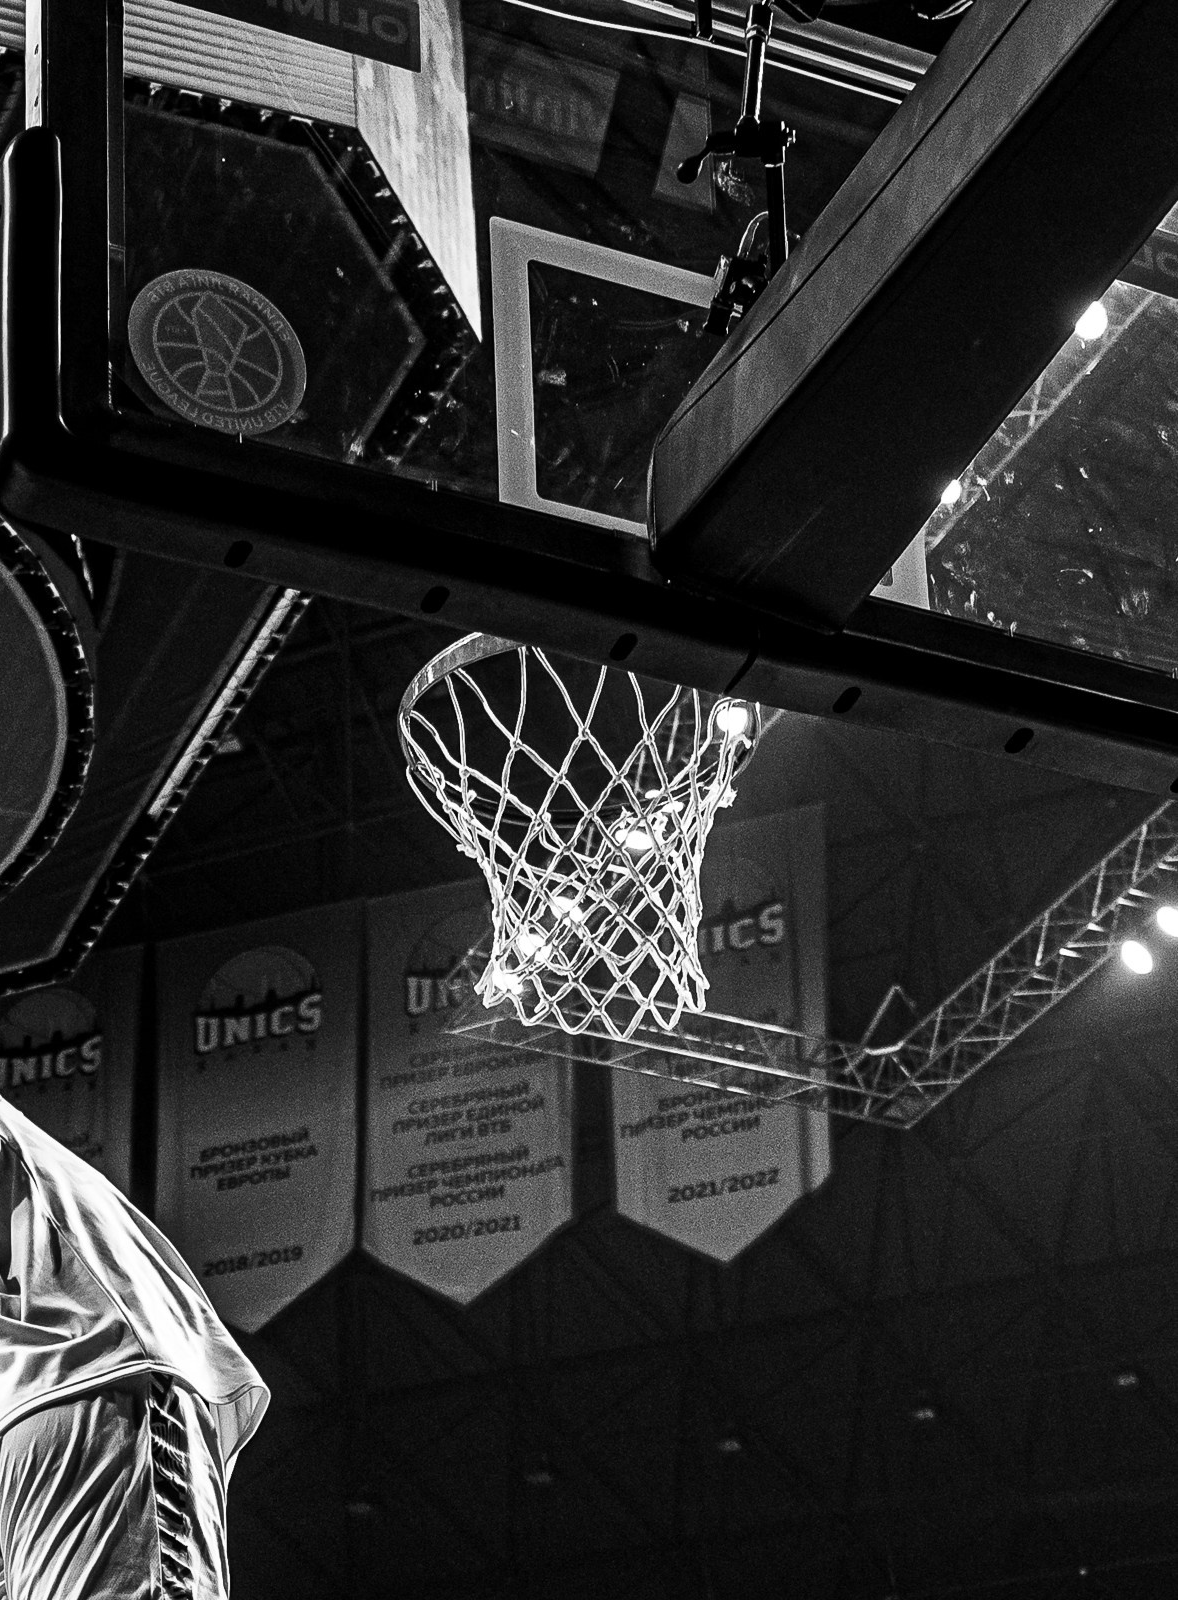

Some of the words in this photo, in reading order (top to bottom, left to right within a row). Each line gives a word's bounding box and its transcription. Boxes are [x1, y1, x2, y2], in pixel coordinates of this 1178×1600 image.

[698, 902, 788, 955] ICS
[195, 992, 322, 1055] UNICS
[667, 1166, 780, 1204] 2021/2022
[412, 1214, 521, 1246] 2020/2021
